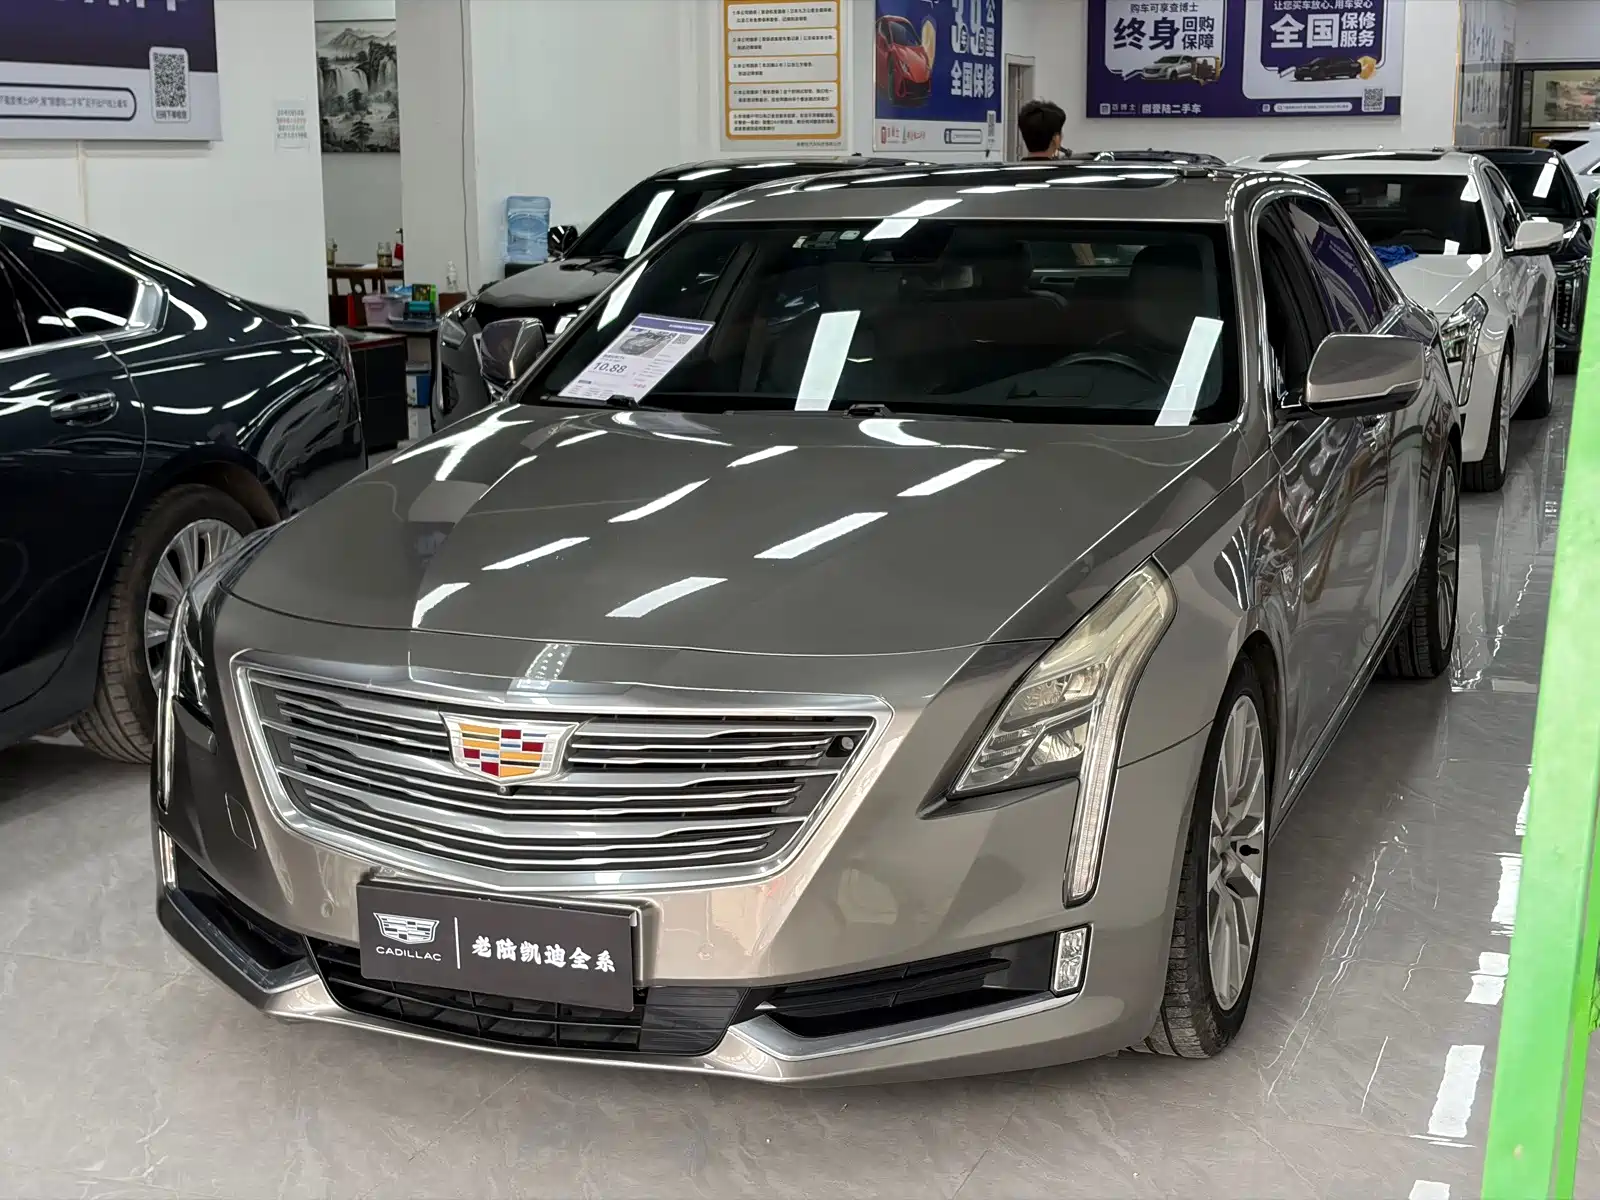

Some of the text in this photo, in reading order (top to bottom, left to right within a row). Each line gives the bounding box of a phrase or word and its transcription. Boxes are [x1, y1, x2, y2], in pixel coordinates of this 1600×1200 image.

[1130, 3, 1199, 13] 购车可享查博士
[1182, 16, 1215, 32] 回购
[1341, 12, 1376, 30] 保修
[1113, 17, 1180, 50] 终身
[1270, 13, 1340, 48] 全国
[1340, 30, 1375, 48] 服务
[1182, 34, 1215, 50] 保障
[950, 59, 994, 98] 全国保修
[593, 362, 628, 374] 10.88
[376, 946, 442, 962] CADILLAC
[471, 935, 616, 973] 老陆凯迪全系
